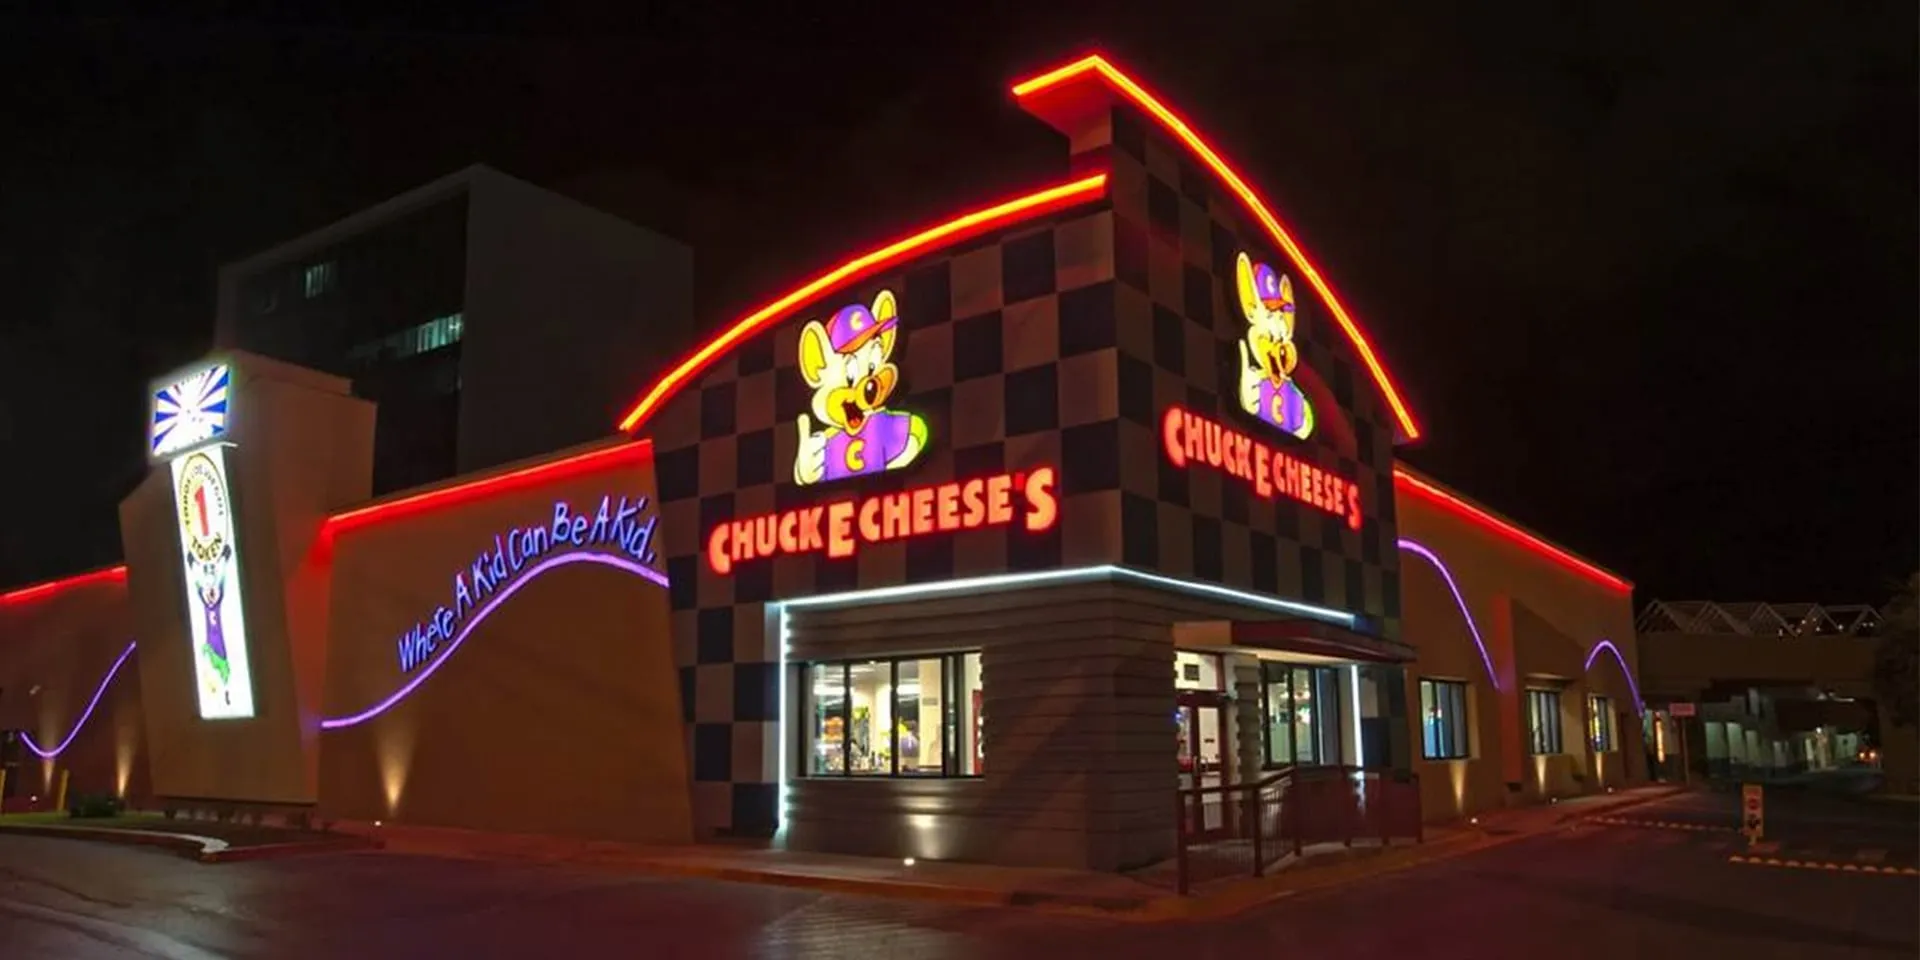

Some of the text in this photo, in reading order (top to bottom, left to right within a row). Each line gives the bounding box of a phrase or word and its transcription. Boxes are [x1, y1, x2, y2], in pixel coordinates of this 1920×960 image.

[850, 311, 863, 330] C
[1271, 395, 1283, 424] C
[845, 439, 865, 472] C
[1164, 407, 1362, 530] CHUCK E CHEESE'S
[194, 485, 210, 537] 1
[708, 467, 1057, 574] CHUCK E CHEESE'S
[191, 532, 222, 561] TOKEN
[398, 606, 455, 672] Where
[455, 572, 473, 619] A
[471, 535, 508, 599] Kid
[508, 526, 549, 571] Can
[551, 502, 588, 545] Be
[589, 496, 610, 542] A
